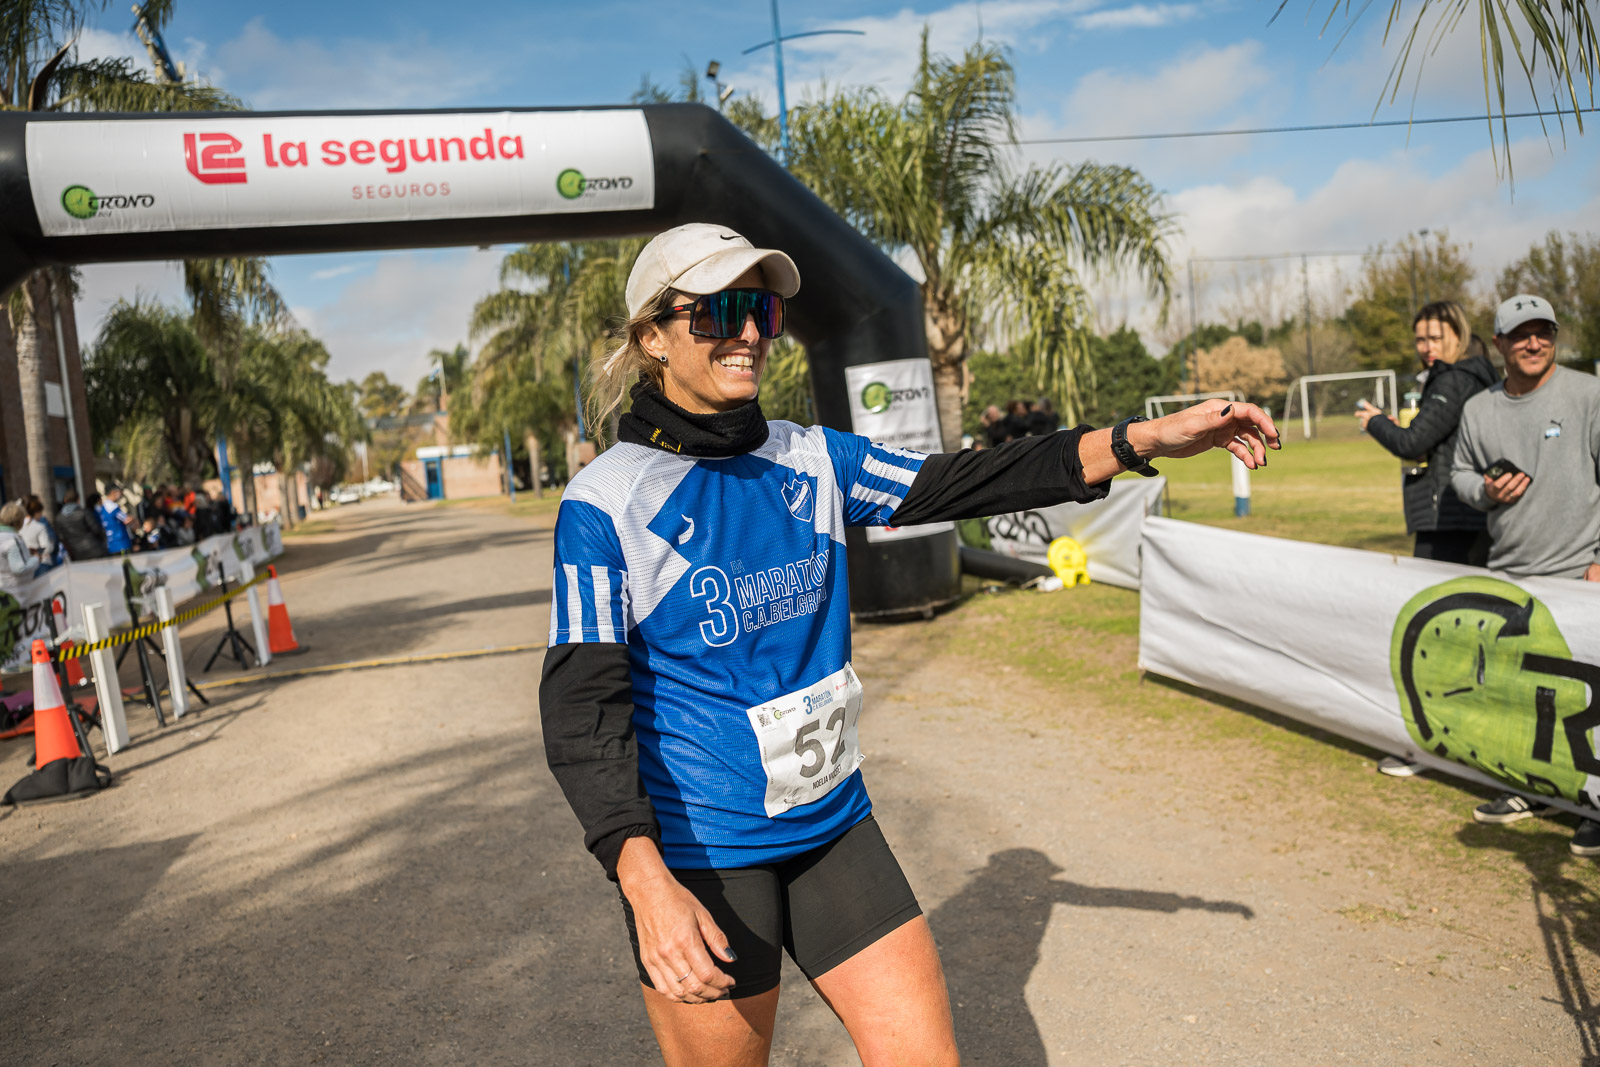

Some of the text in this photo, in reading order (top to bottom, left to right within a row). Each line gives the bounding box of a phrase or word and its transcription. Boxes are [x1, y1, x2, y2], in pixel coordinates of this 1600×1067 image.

[262, 128, 525, 173] la segunda
[352, 182, 451, 200] SEGUROS
[689, 565, 739, 647] 3
[795, 707, 846, 778] 52
[812, 775, 829, 790] NOELIA
